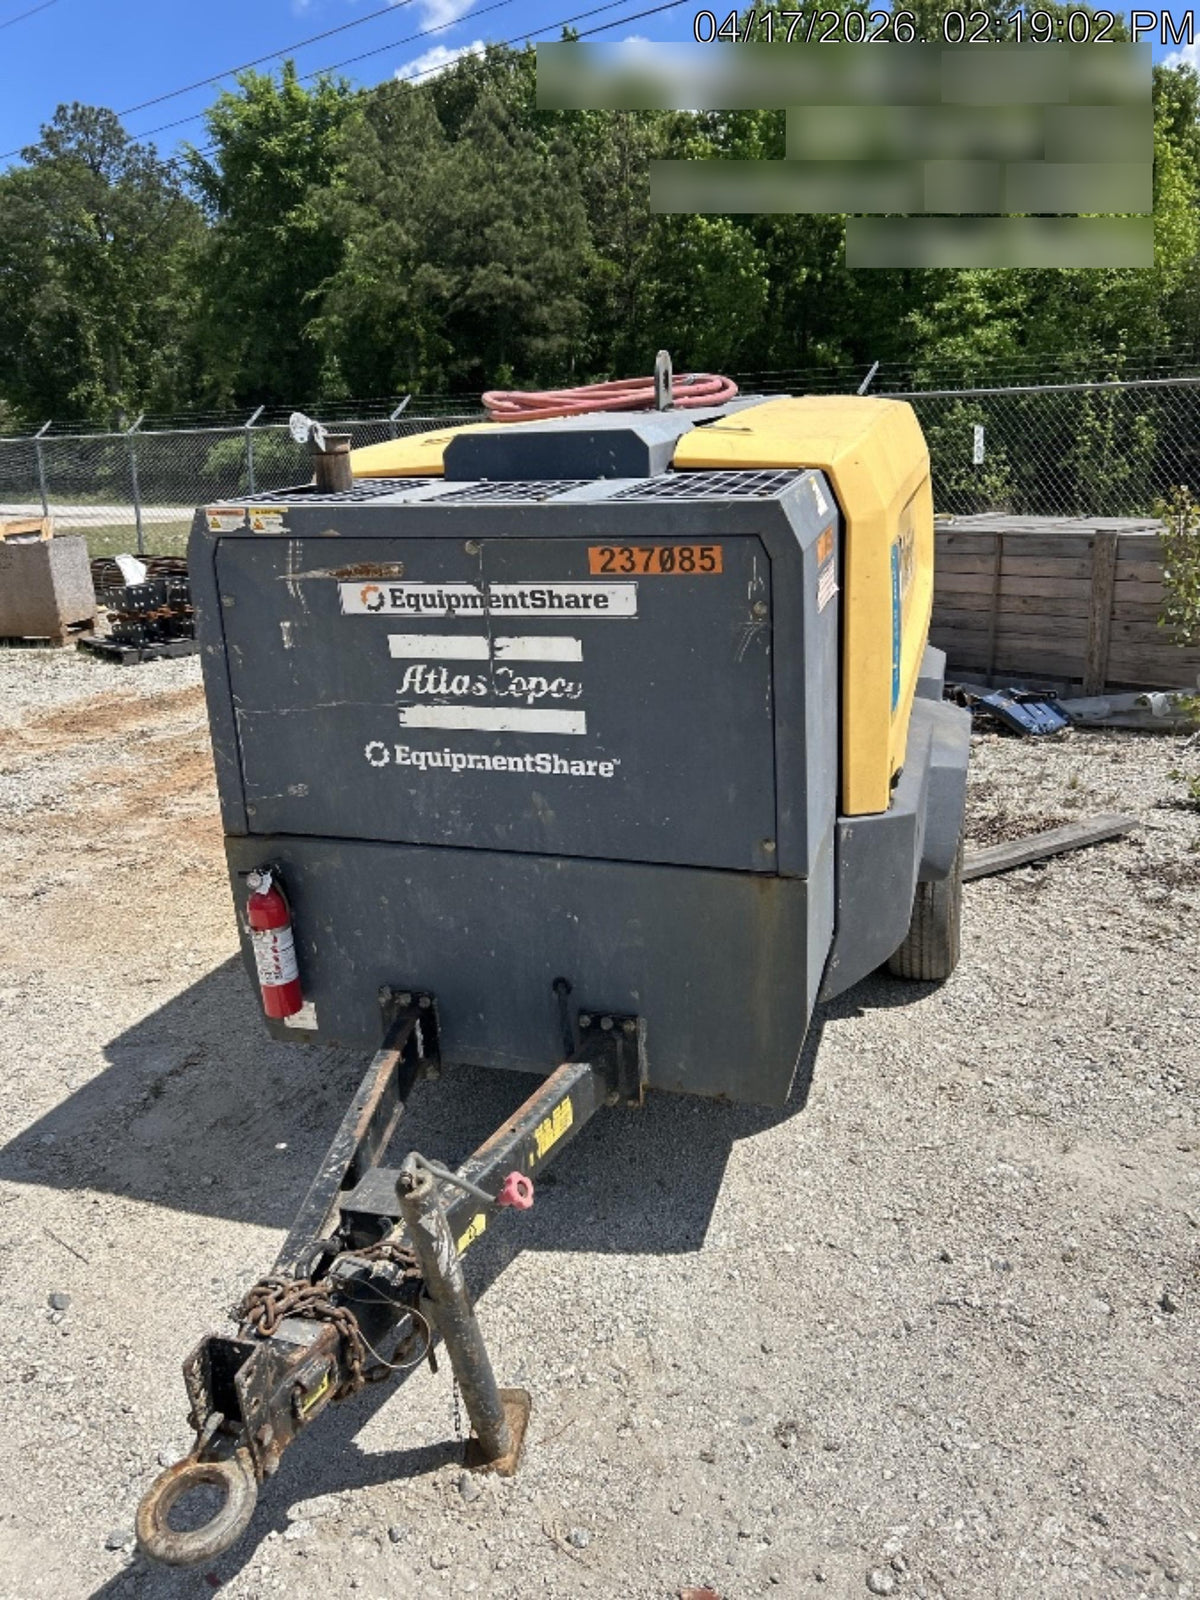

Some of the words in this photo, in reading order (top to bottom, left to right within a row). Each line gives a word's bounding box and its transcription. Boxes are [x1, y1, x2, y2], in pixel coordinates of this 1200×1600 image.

[599, 547, 716, 573] 237085
[389, 589, 609, 613] EquipmentShare
[396, 664, 488, 696] Atlas
[394, 744, 615, 778] EquipmentShare
